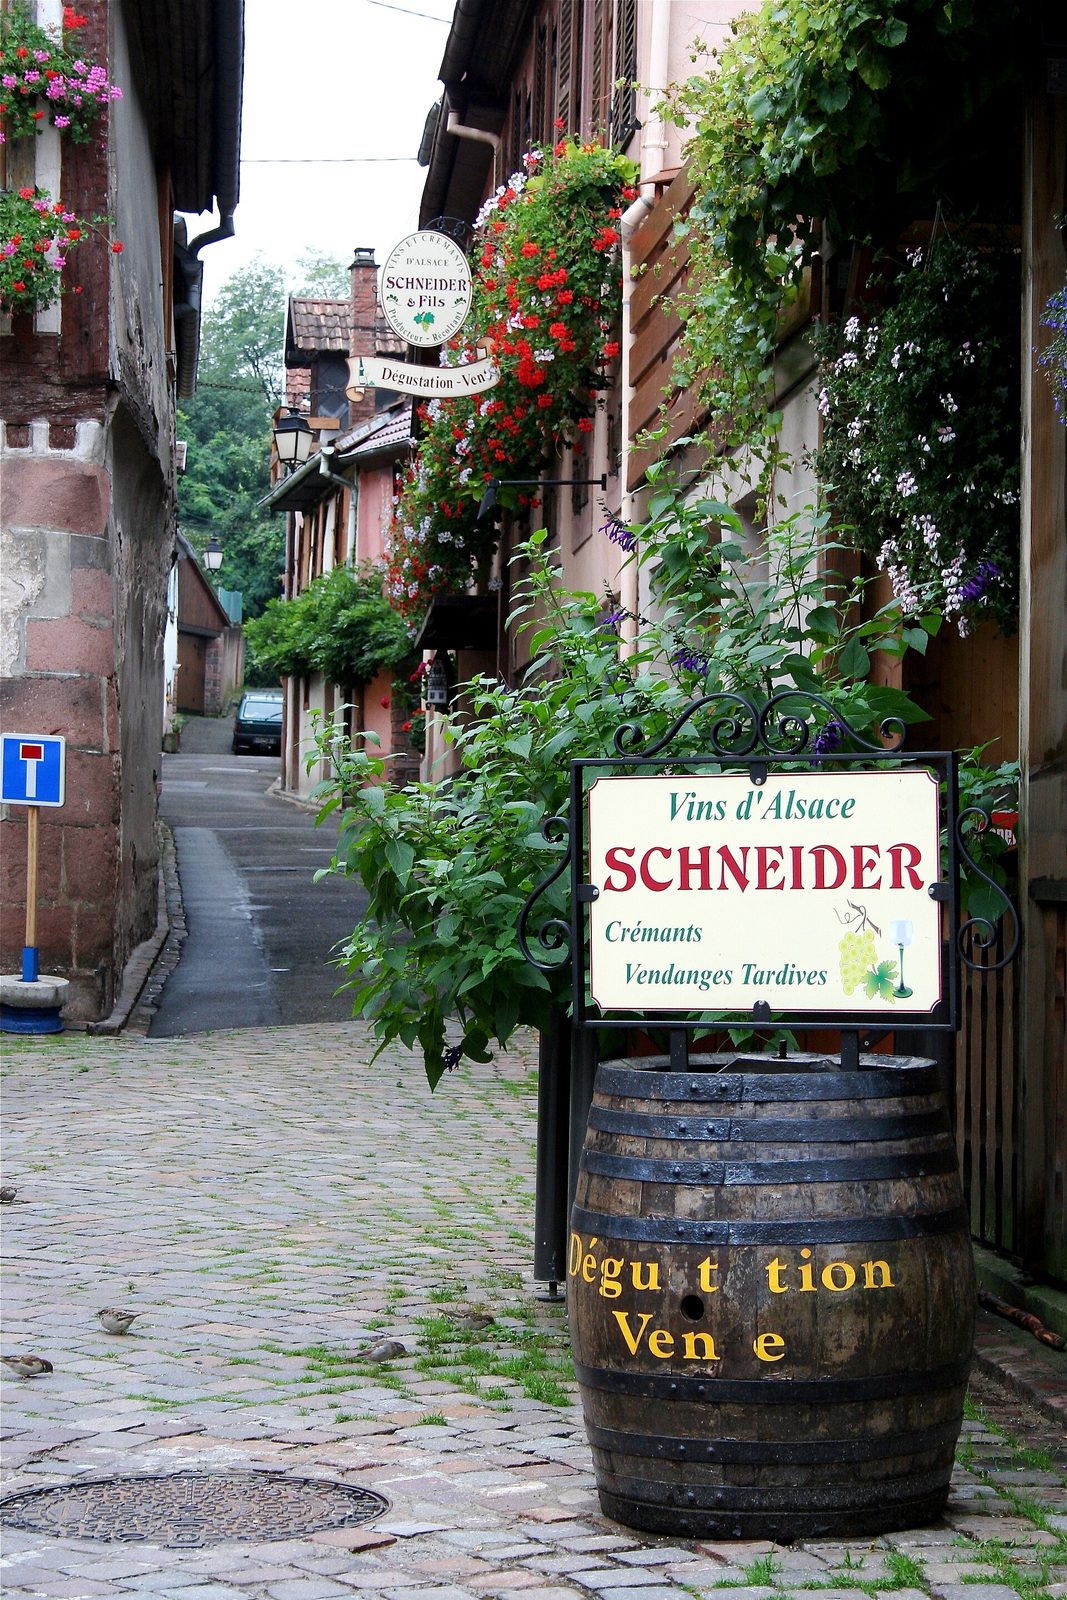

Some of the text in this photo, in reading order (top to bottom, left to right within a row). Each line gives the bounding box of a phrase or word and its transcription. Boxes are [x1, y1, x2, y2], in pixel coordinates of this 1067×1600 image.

[388, 248, 405, 269] VINS
[406, 237, 418, 248] ET
[406, 258, 450, 267] D'ALSACE
[386, 276, 467, 292] SCHNEIDER
[407, 295, 446, 308] & Fils
[388, 308, 423, 343] Producteur
[381, 367, 454, 389] Dégustation
[668, 790, 856, 822] Vins d'Alsace
[603, 843, 925, 893] SCHNEIDER
[605, 920, 703, 943] Crémants
[624, 963, 828, 992] Vendanges Tardives
[611, 1310, 787, 1362] Vene
